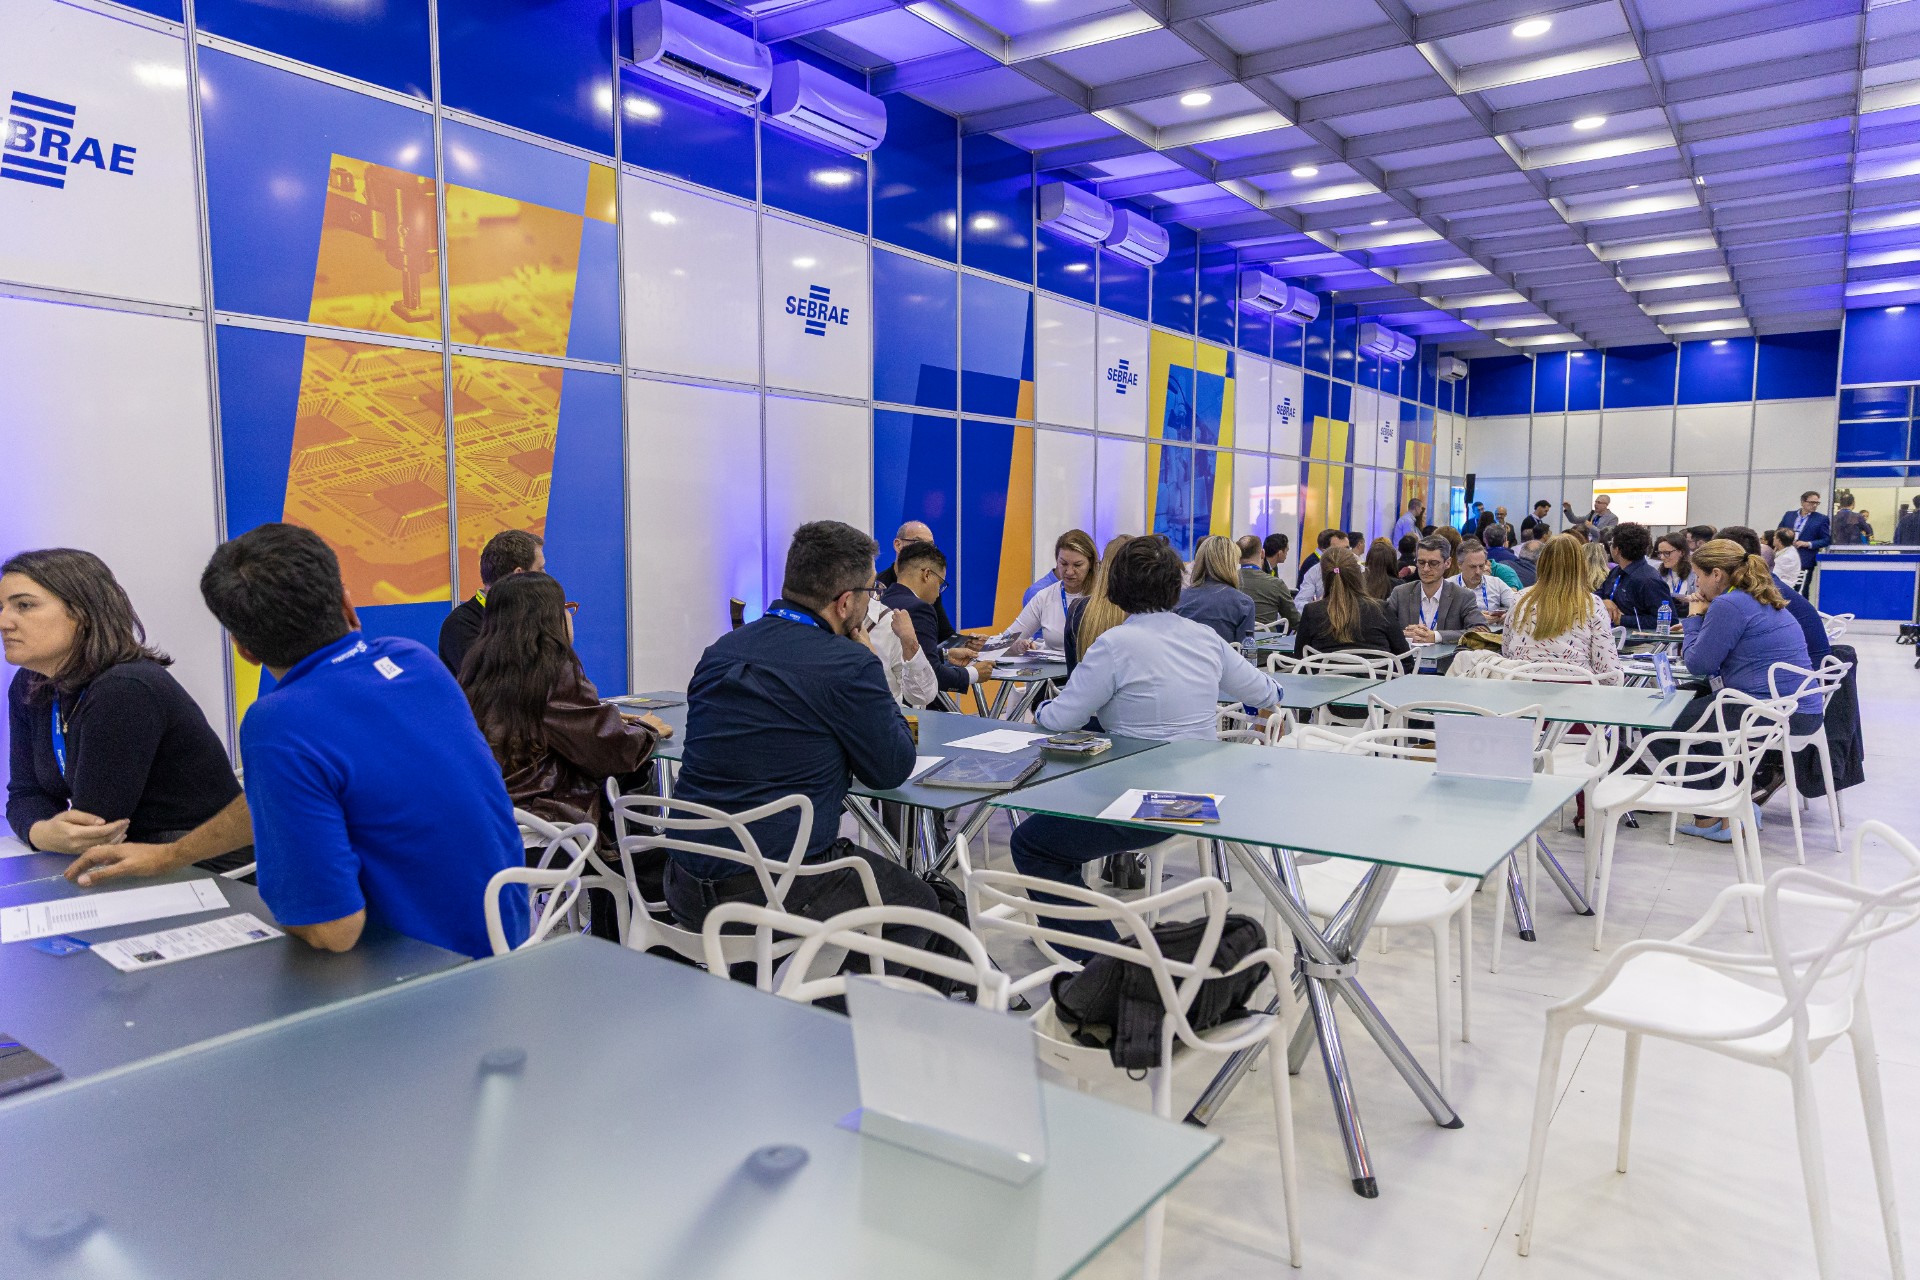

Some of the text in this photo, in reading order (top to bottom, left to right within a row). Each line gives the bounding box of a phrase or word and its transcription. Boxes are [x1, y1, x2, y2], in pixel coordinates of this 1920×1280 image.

[0, 117, 137, 176] BRAE
[785, 295, 849, 325] SEBRAE
[1107, 367, 1138, 386] SEBRAE
